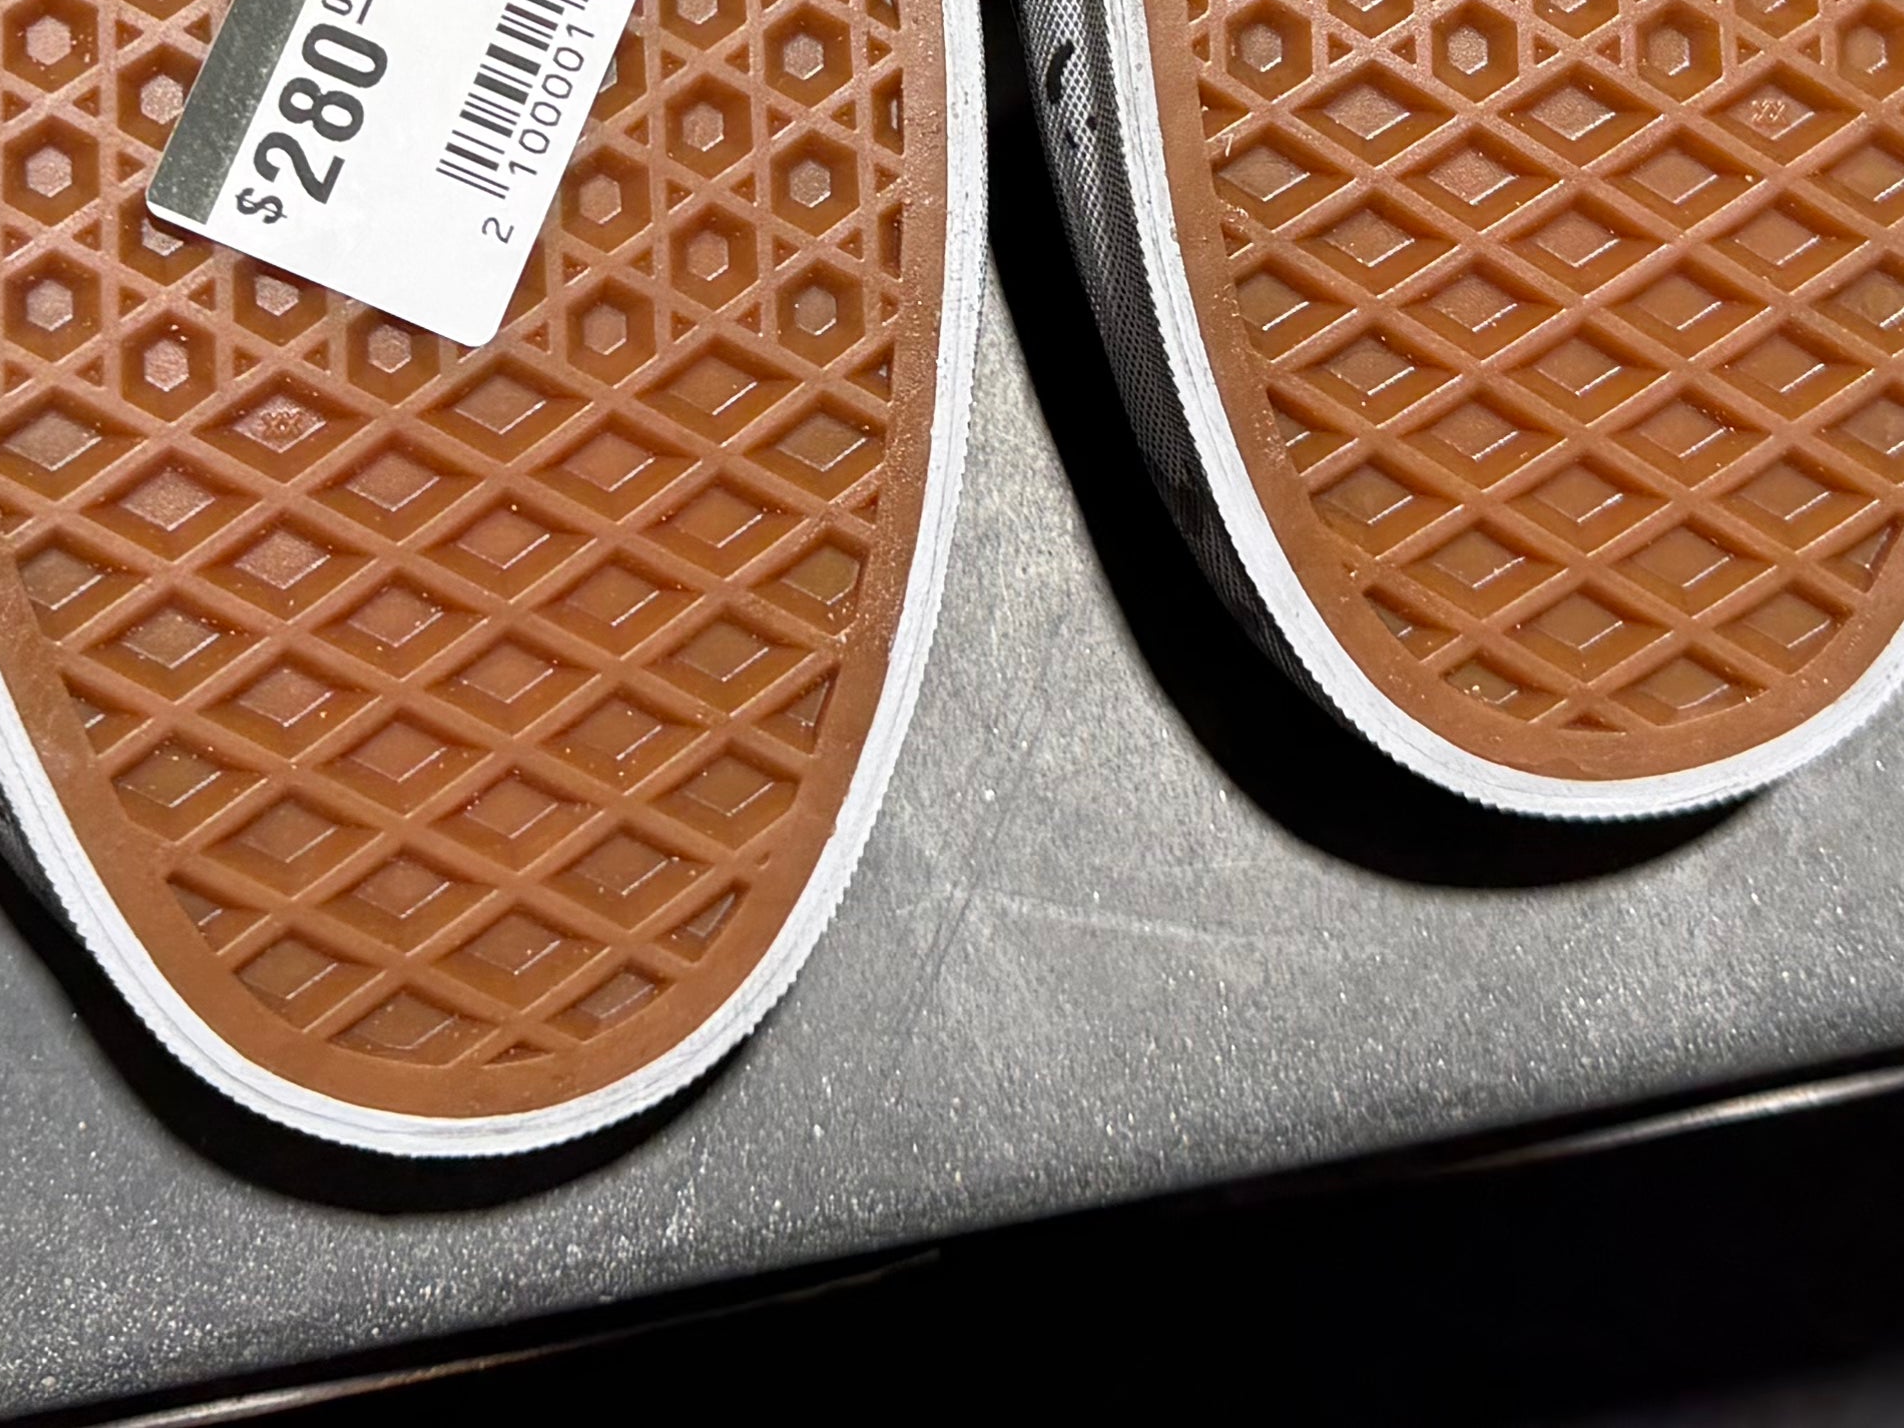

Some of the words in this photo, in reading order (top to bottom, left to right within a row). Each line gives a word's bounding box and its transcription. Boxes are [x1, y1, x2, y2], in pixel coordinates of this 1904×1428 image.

[234, 21, 389, 225] $280
[480, 216, 515, 245] 2
[507, 22, 596, 178] 100001
